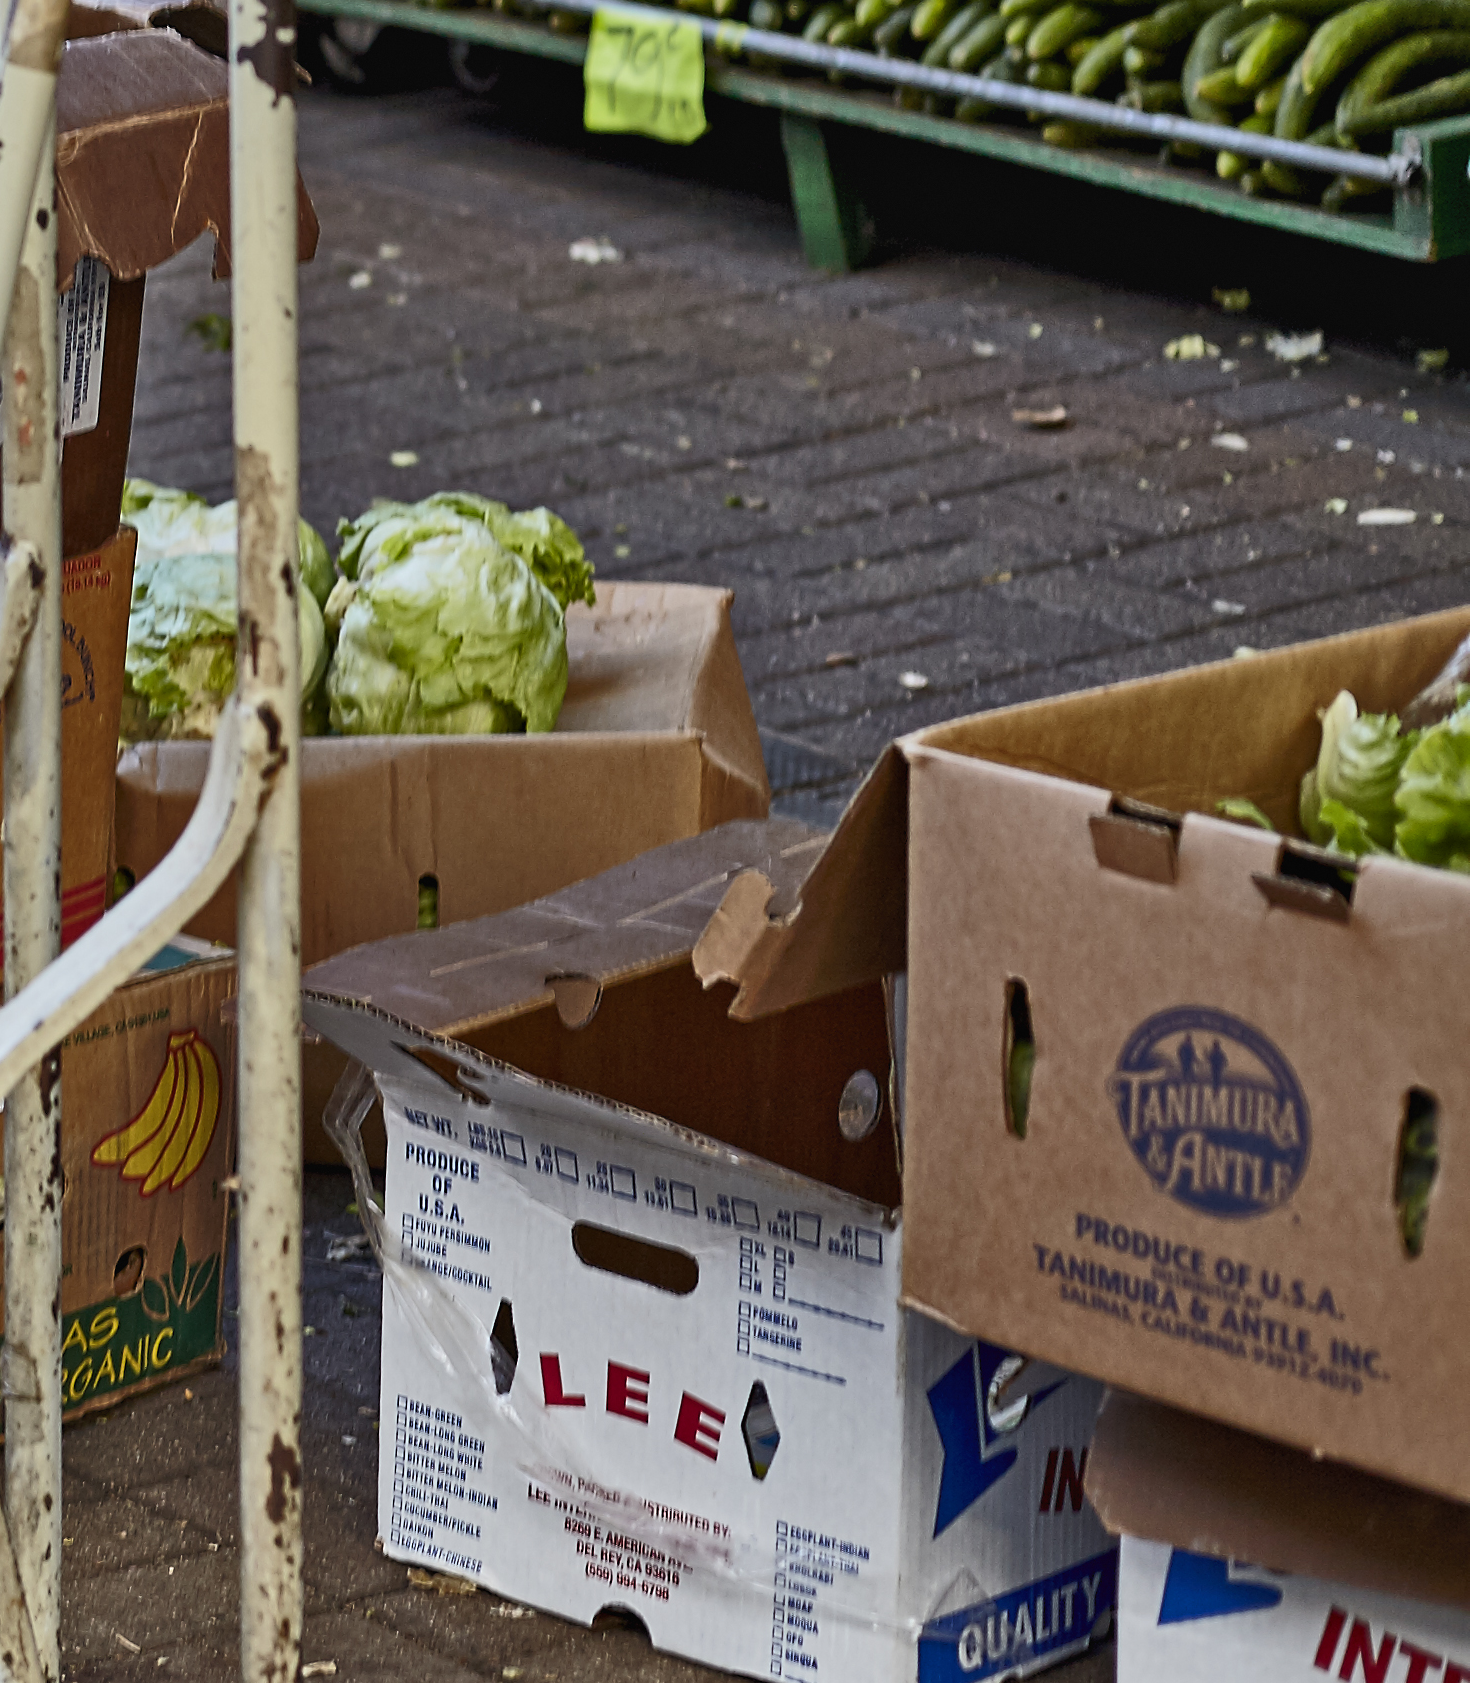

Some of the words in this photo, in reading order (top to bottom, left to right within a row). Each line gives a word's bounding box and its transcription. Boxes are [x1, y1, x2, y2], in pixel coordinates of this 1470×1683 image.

[1105, 1067, 1301, 1150] TANIMURA
[406, 1141, 480, 1183] PRODUCE
[1147, 1132, 1167, 1169] &
[1165, 1130, 1295, 1205] ANTLE
[432, 1174, 453, 1194] OF
[419, 1193, 465, 1226] U.S.A.
[416, 1218, 437, 1236] FUYU
[440, 1227, 491, 1255] PERSIMMON
[1075, 1212, 1205, 1275] PRODUCE
[1214, 1257, 1251, 1291] OF
[1261, 1270, 1346, 1322] U.S.A.
[1033, 1243, 1180, 1318] TANIMURA
[1188, 1297, 1210, 1324] &
[1221, 1303, 1319, 1364] ANTLE,
[1330, 1337, 1391, 1384] INC.
[1141, 1309, 1247, 1360] CALIFORNIA
[409, 1399, 462, 1428] BEAN-GREEN
[539, 1352, 726, 1463] LEE
[408, 1417, 456, 1443] BEAN-LONG
[458, 1432, 485, 1454] GREEN
[408, 1434, 455, 1460] BEAN-LONG
[457, 1448, 483, 1471] WHITE
[407, 1450, 434, 1472] BITTER
[437, 1461, 467, 1482] MELON
[406, 1467, 434, 1488] BITTER
[436, 1476, 498, 1511] MELON-INDIAN
[402, 1518, 434, 1539] DAIKON
[404, 1501, 482, 1538] CUCUMBER/PICKLE
[401, 1534, 483, 1573] EGGPLANT-CHINESE
[576, 1539, 596, 1557] DEL
[601, 1547, 623, 1570] REY,
[626, 1555, 642, 1575] CA
[790, 1524, 870, 1562] EGGPLANT-INDIAN
[958, 1570, 1102, 1673] QUALITY
